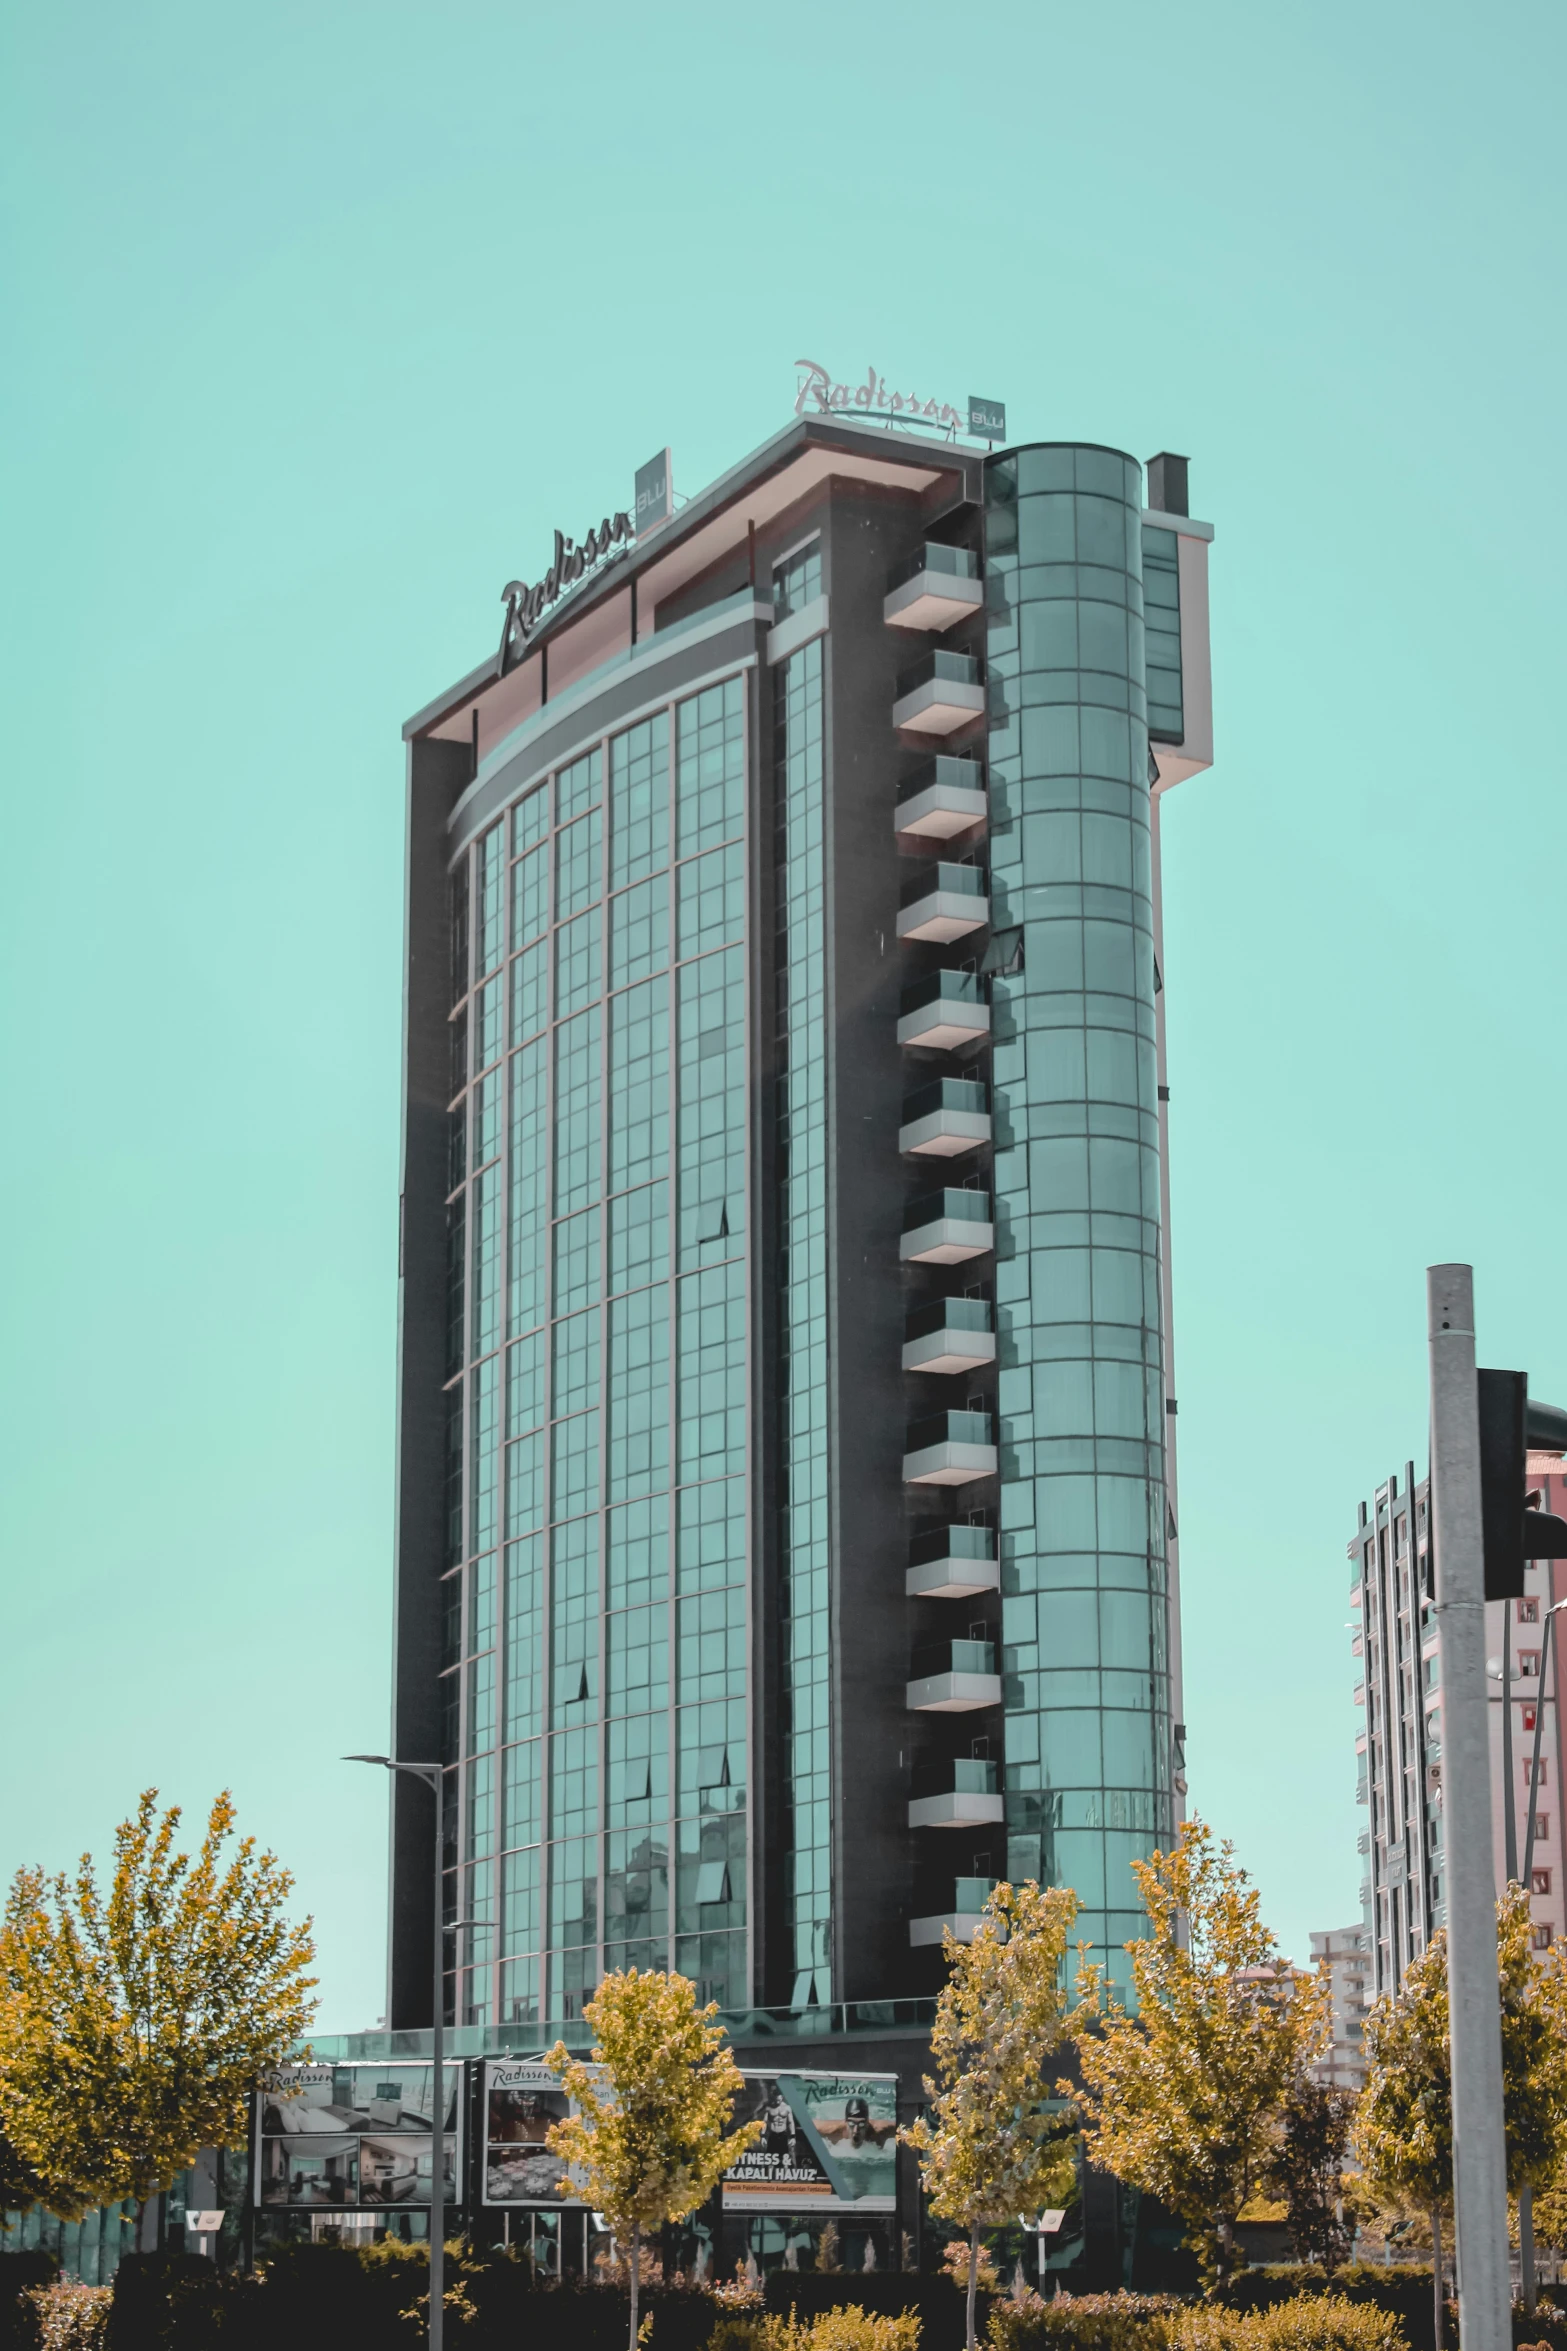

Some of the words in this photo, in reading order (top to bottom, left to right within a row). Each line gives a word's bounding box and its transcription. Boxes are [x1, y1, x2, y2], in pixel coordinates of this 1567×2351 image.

[794, 359, 963, 429] Radisson
[971, 411, 1004, 429] BLU
[500, 511, 636, 680] Radisson
[636, 477, 667, 514] BLU
[268, 2068, 334, 2092] Radisson
[493, 2066, 552, 2088] Radisson
[804, 2076, 875, 2105] Radisson
[735, 2152, 780, 2165] ITNESS
[782, 2153, 792, 2166] &
[775, 2168, 816, 2181] HAVUZ
